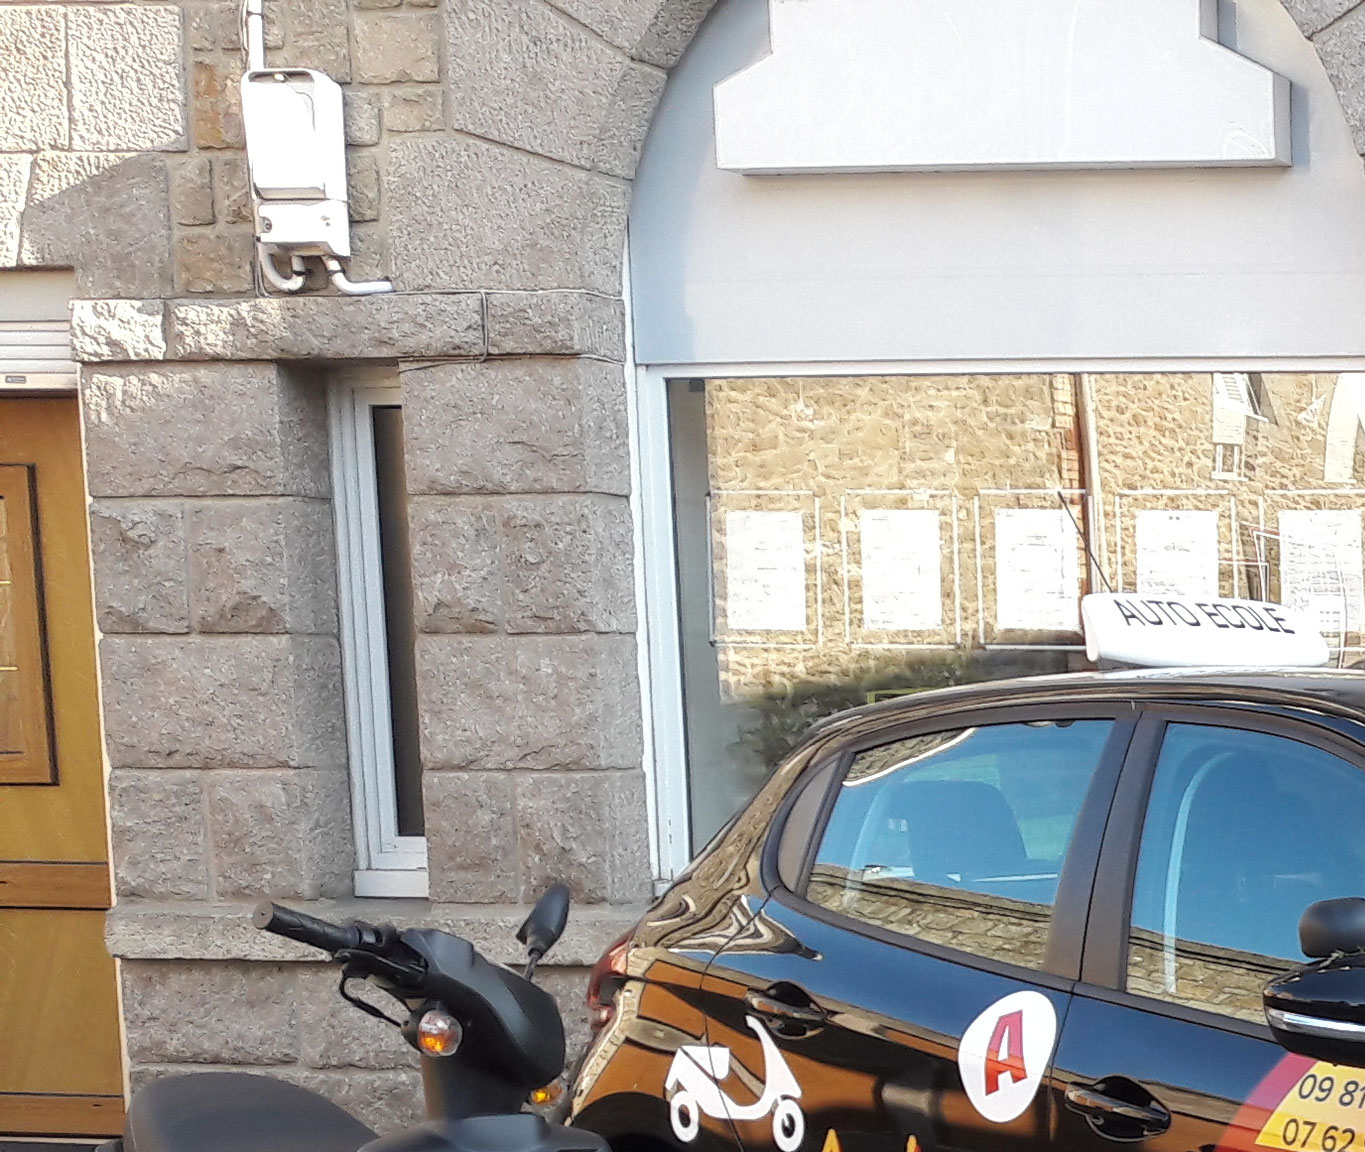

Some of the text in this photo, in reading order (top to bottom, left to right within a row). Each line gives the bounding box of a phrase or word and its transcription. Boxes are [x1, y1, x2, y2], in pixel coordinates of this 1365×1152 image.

[1113, 599, 1296, 635] AUTO ECOLE
[985, 1009, 1028, 1096] A
[1298, 1073, 1334, 1102] 09
[1282, 1117, 1317, 1148] 07
